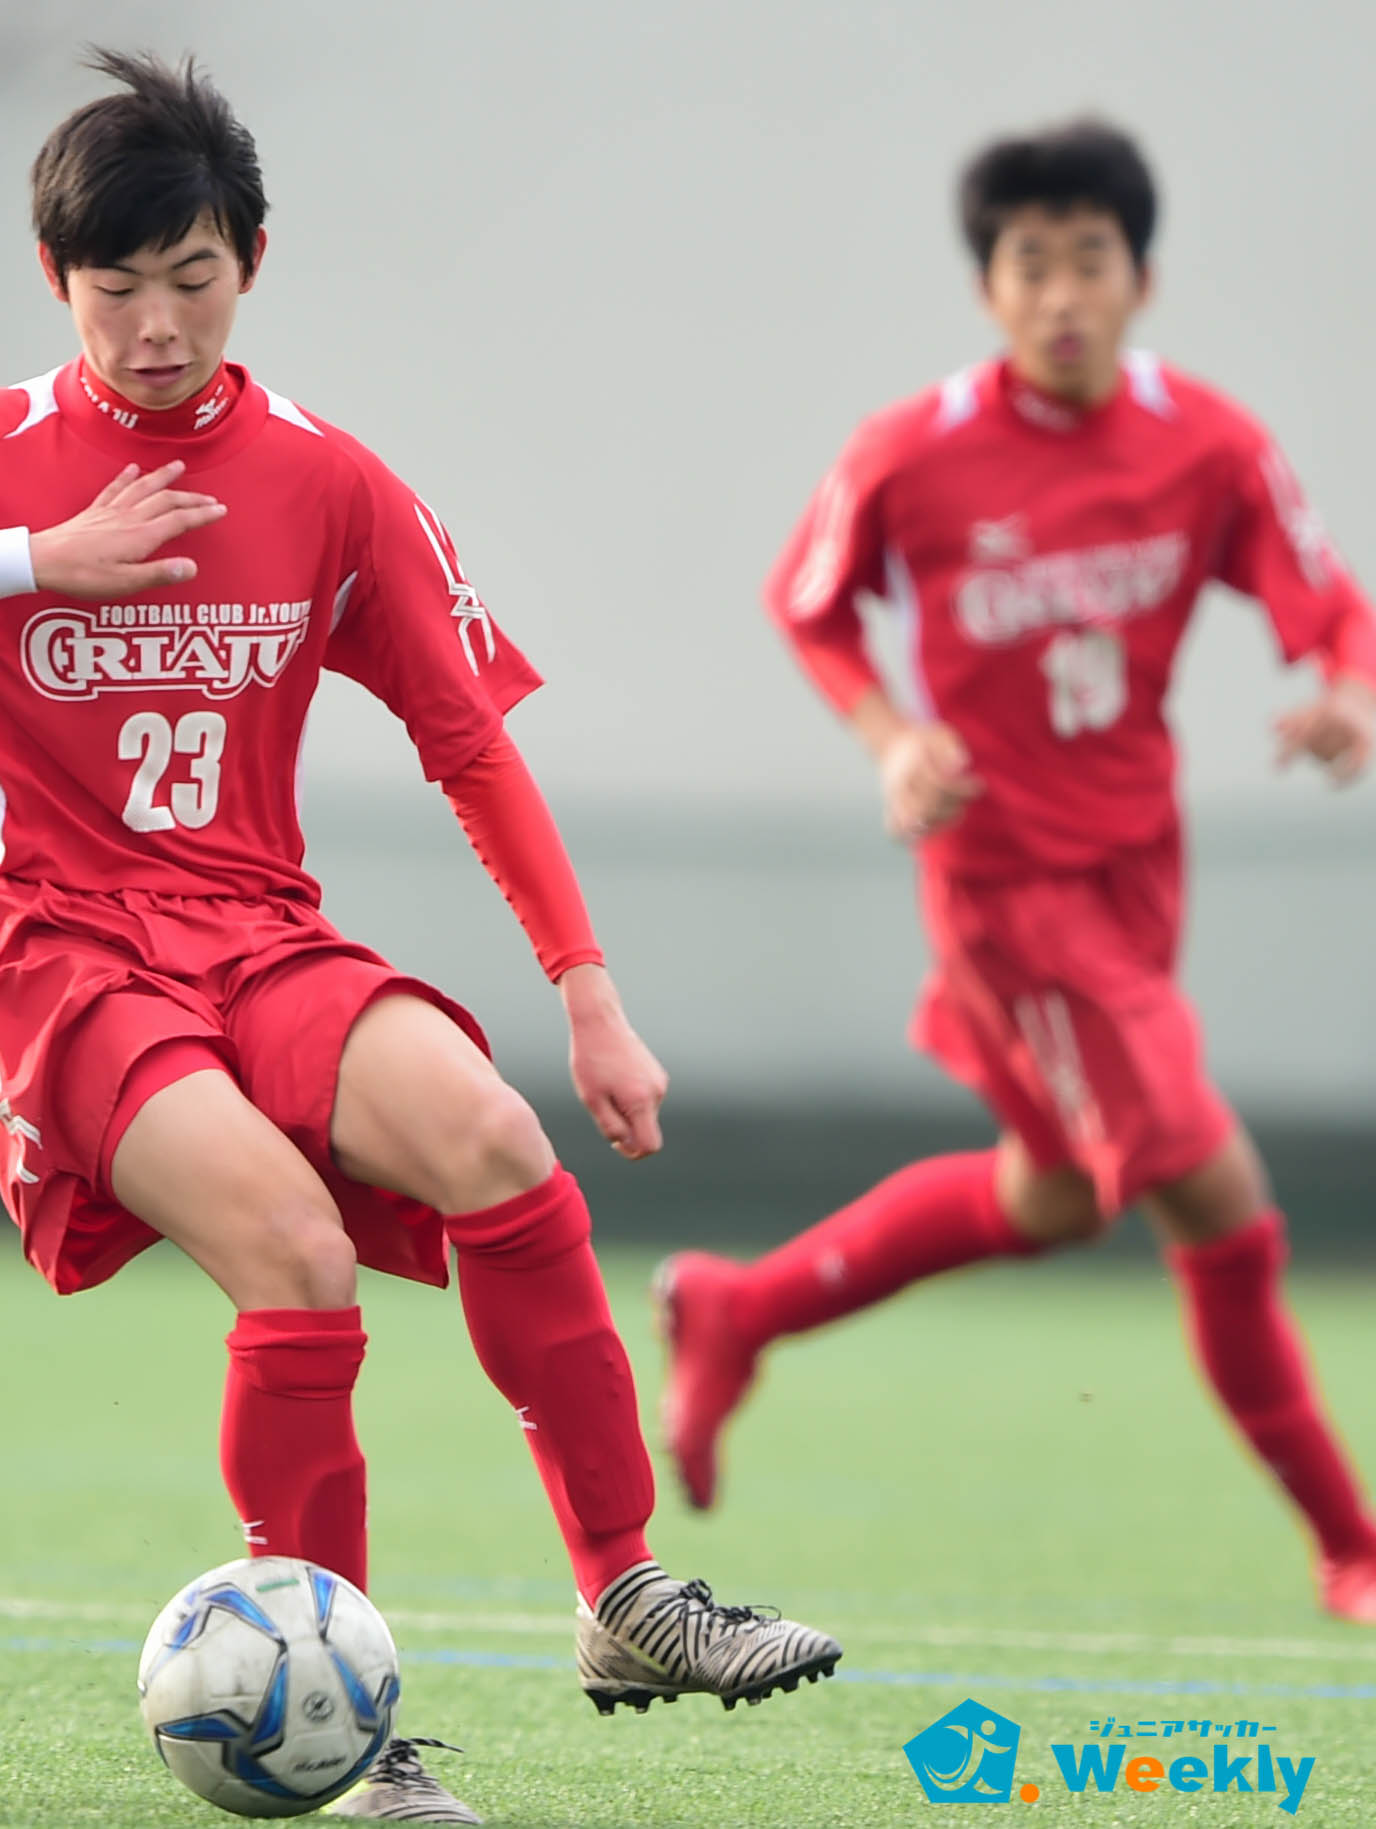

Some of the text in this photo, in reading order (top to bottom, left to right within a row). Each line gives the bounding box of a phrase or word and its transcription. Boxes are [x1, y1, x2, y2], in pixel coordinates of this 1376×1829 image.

[100, 604, 193, 626] FOOTBALL
[197, 604, 244, 625] CLUB
[117, 711, 227, 832] 23
